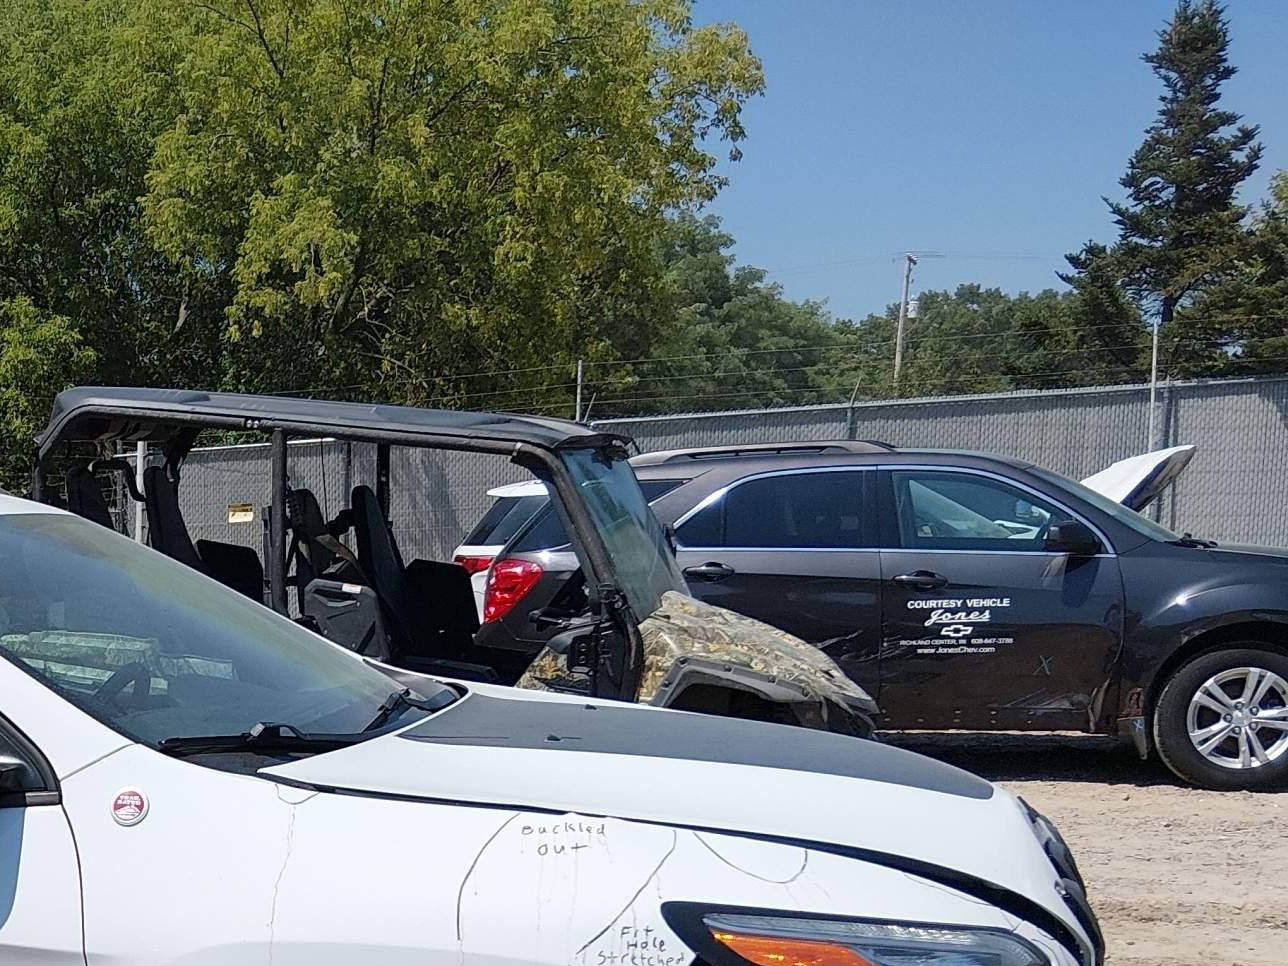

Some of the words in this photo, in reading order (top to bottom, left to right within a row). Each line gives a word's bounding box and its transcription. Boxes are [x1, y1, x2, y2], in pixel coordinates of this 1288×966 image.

[907, 599, 963, 609] COURTESY
[966, 598, 1011, 608] VEHICLE
[924, 608, 991, 626] Jones
